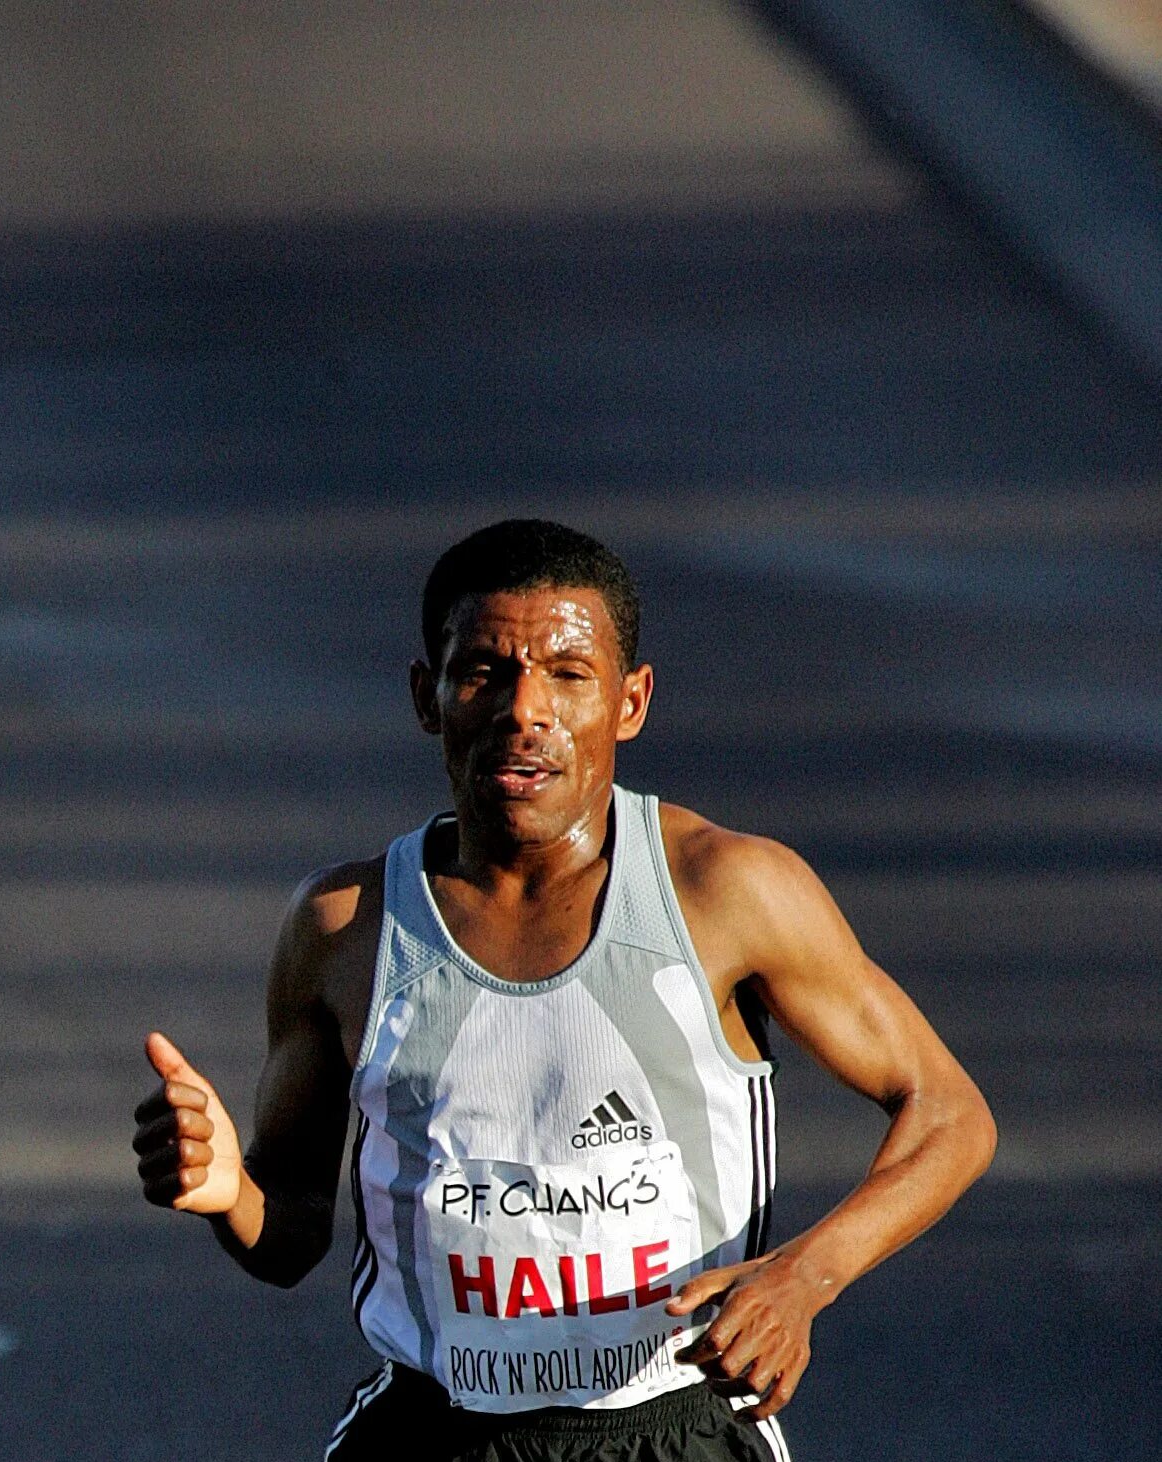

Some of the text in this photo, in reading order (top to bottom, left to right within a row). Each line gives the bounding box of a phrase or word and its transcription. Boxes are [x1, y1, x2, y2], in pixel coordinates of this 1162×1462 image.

[571, 1123, 653, 1149] adidas
[441, 1171, 660, 1225] P.F. CHANG'S
[448, 1239, 672, 1318] HAILE
[450, 1345, 500, 1395] ROCK
[503, 1352, 527, 1396] 'N'
[534, 1347, 588, 1393] ROLL
[592, 1332, 672, 1391] ARIZONA
